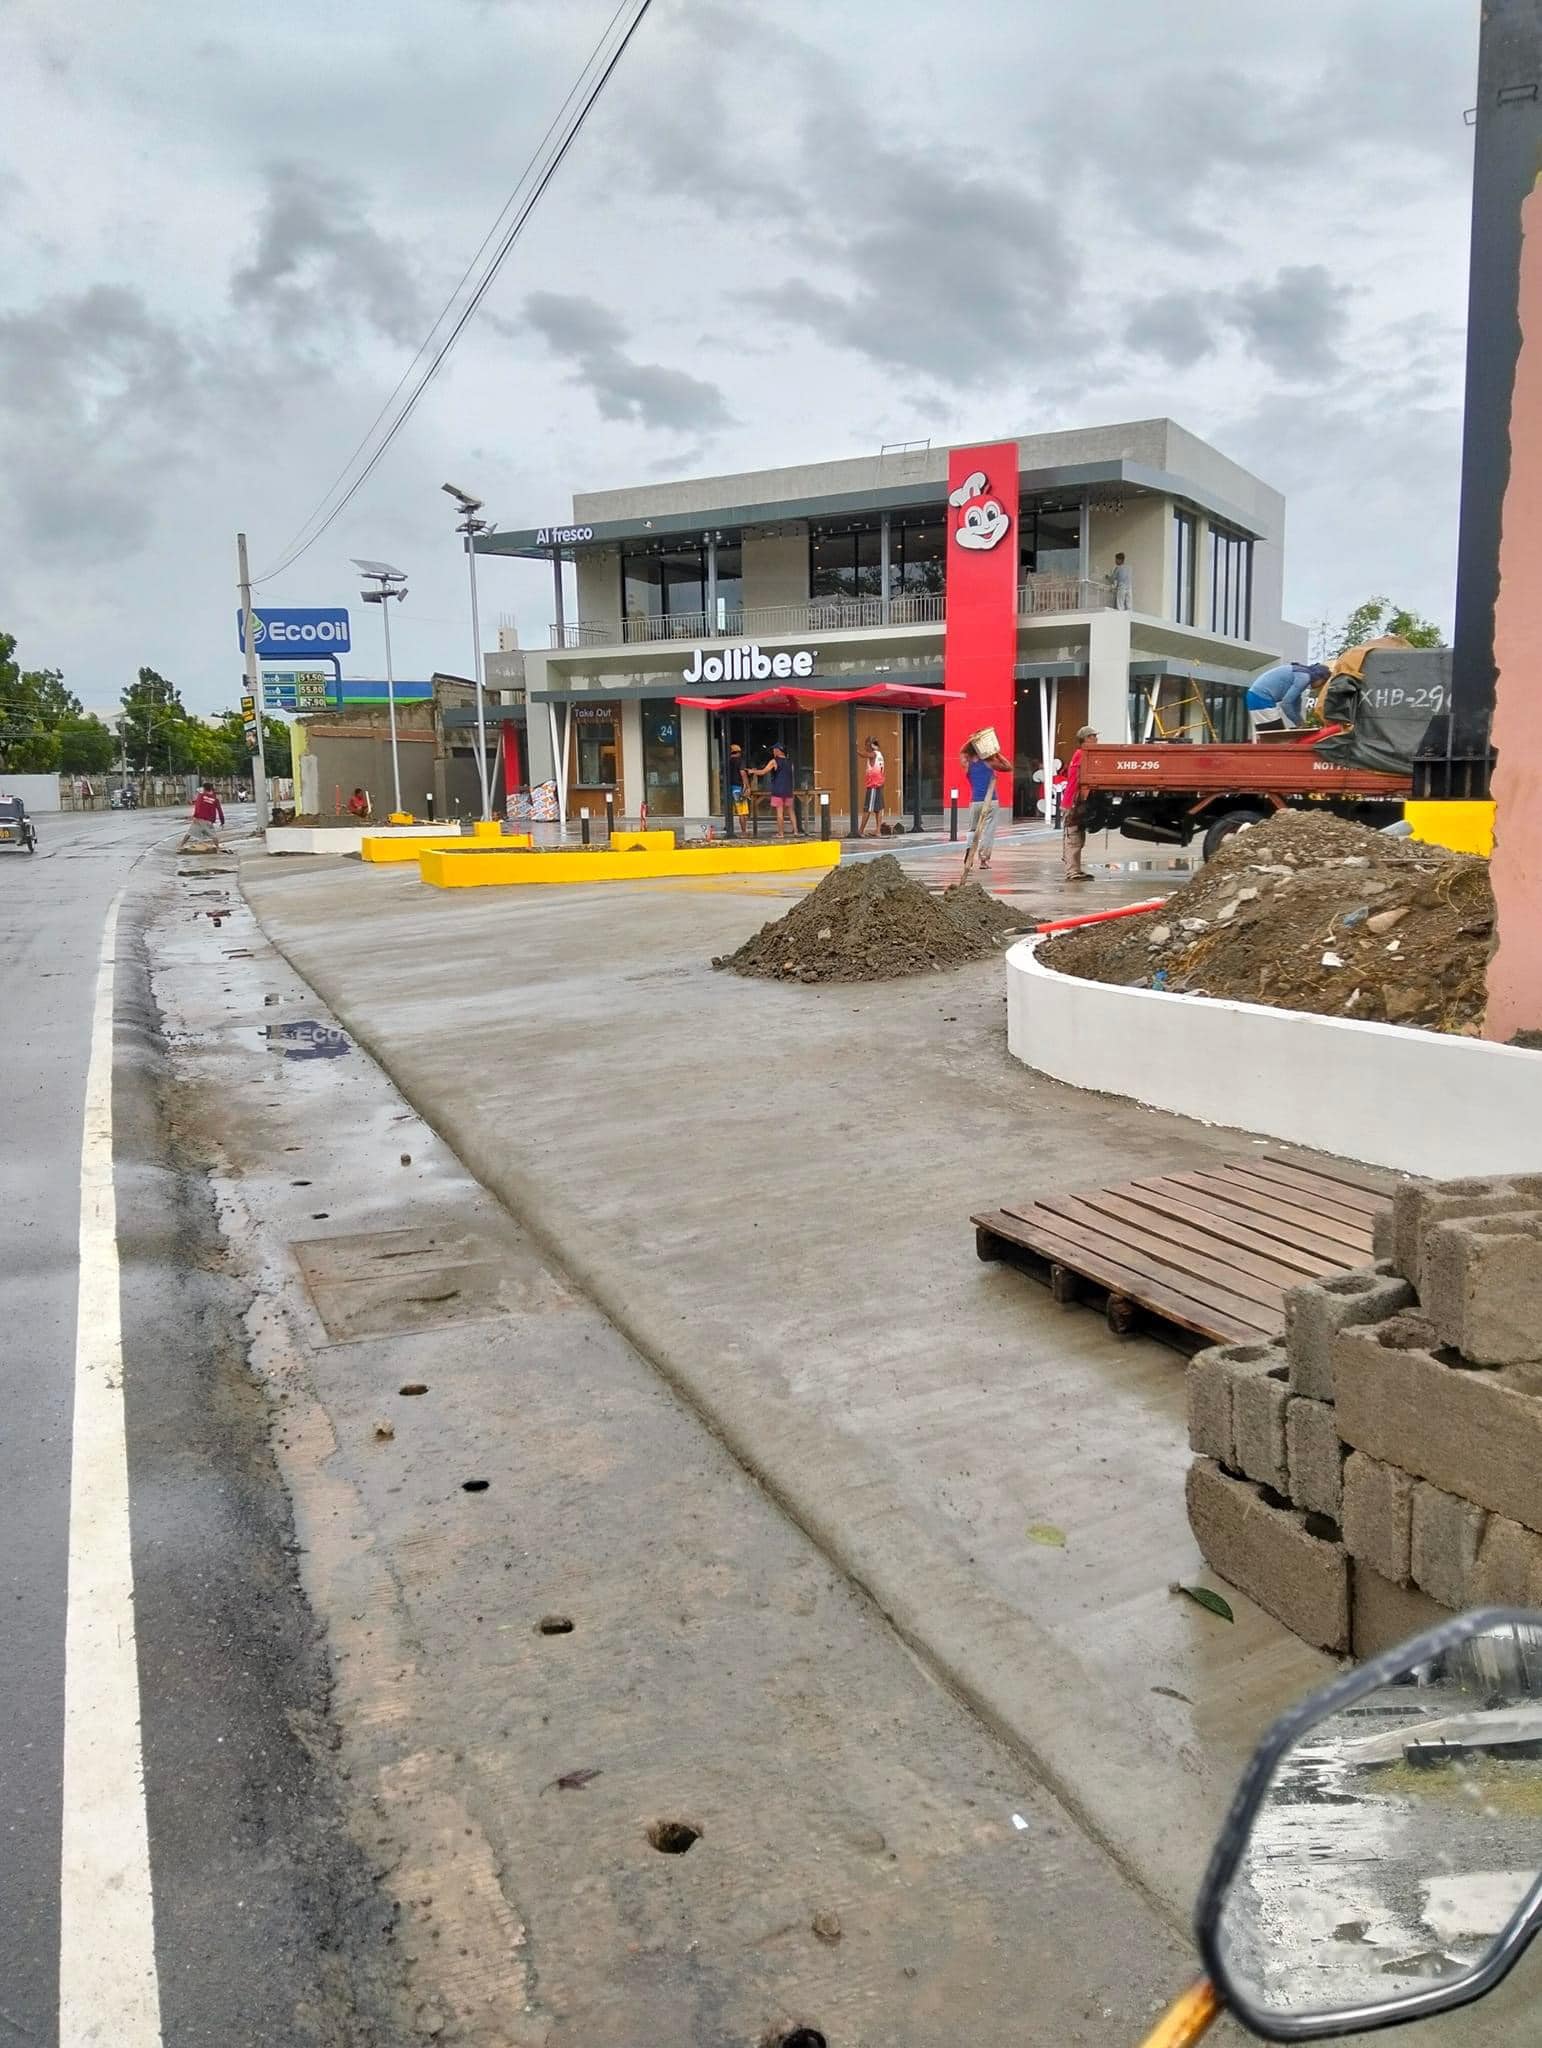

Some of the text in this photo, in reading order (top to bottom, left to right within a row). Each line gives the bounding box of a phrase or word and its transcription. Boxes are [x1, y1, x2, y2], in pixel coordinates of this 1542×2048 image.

[536, 526, 594, 545] Al fresco
[268, 621, 348, 641] EcoOil
[682, 645, 816, 684] Jollibee
[1358, 685, 1452, 712] XHB-29
[574, 708, 612, 718] Take Out
[660, 726, 673, 736] 24
[1116, 761, 1160, 770] XHB-296
